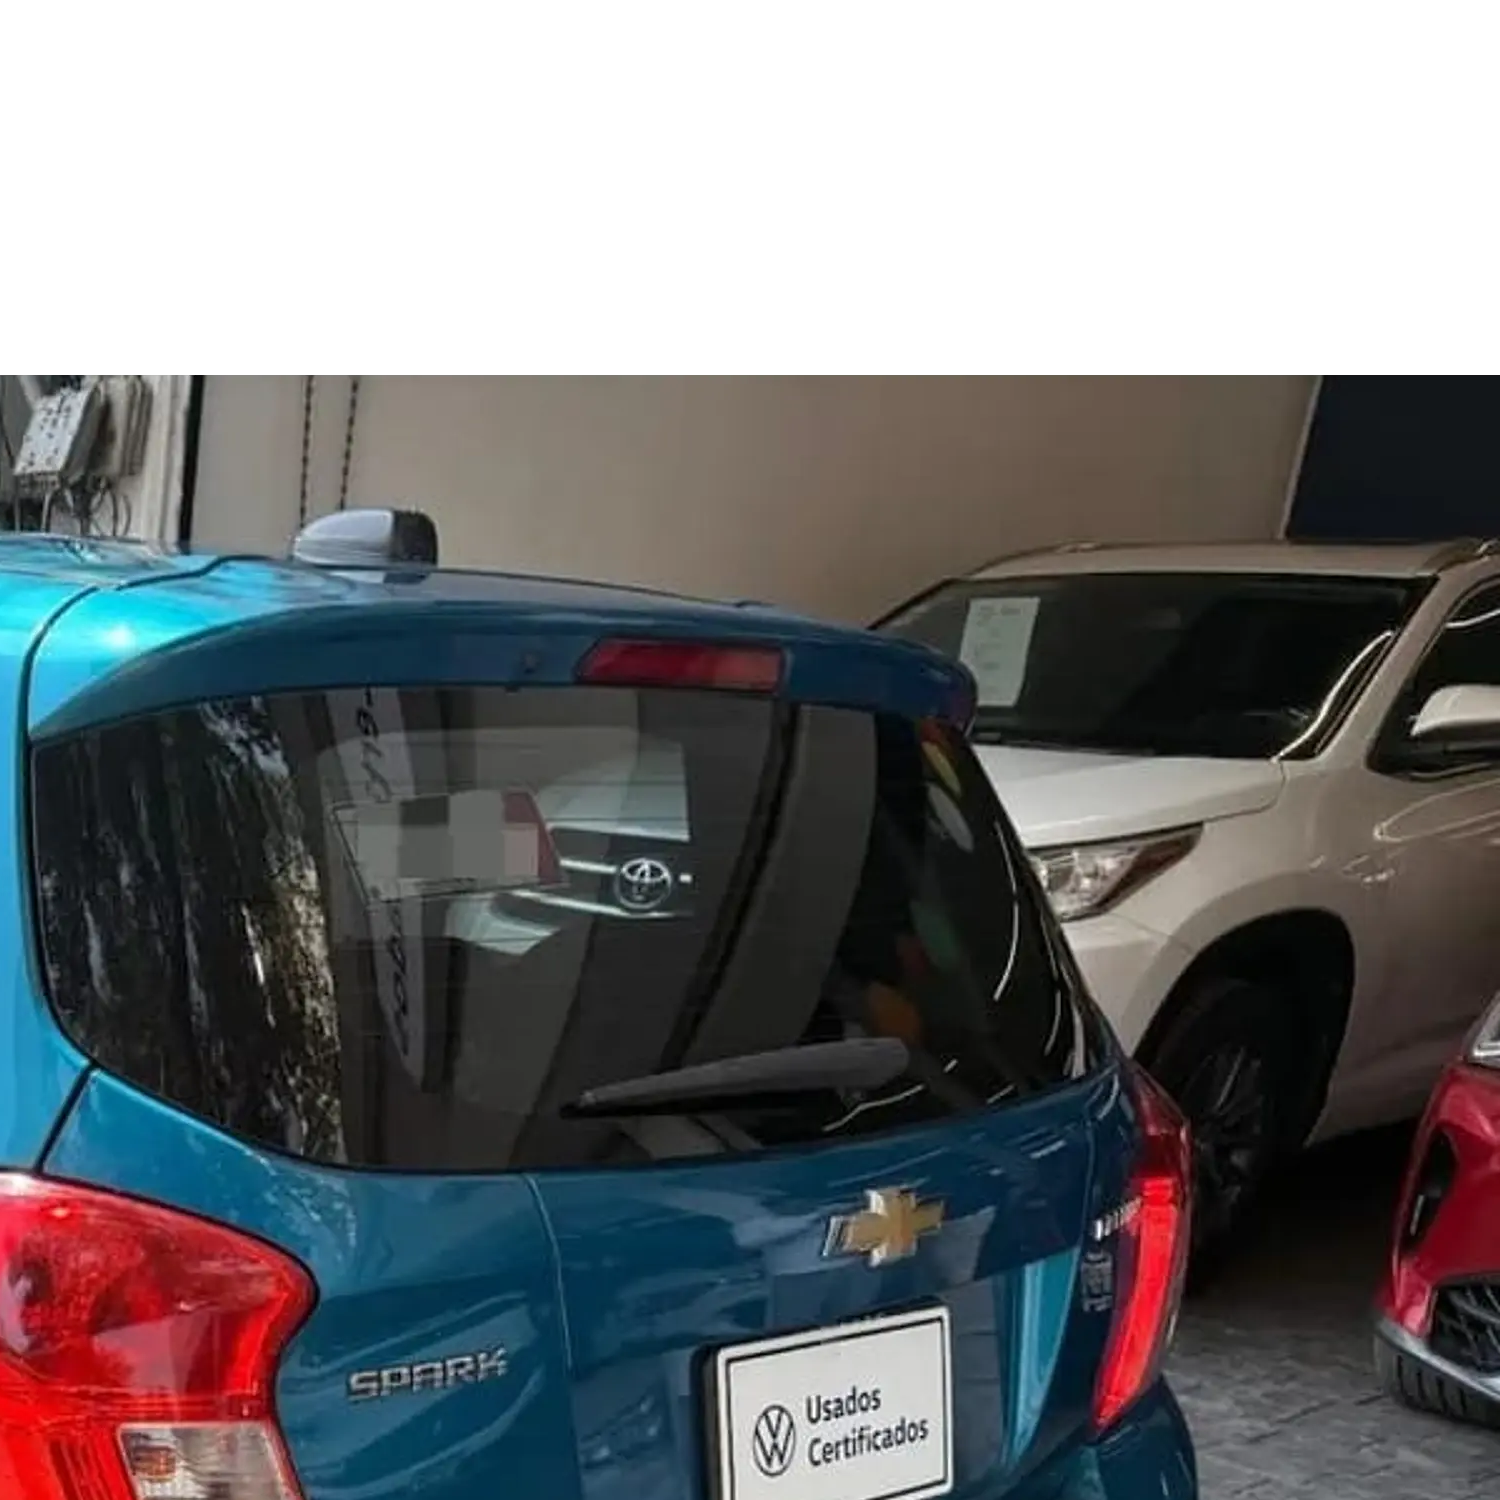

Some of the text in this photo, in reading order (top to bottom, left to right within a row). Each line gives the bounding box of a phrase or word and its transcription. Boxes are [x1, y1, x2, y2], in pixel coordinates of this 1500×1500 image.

[348, 1347, 508, 1400] SPARK
[805, 1386, 882, 1424] Usados
[807, 1417, 929, 1467] Certificados
